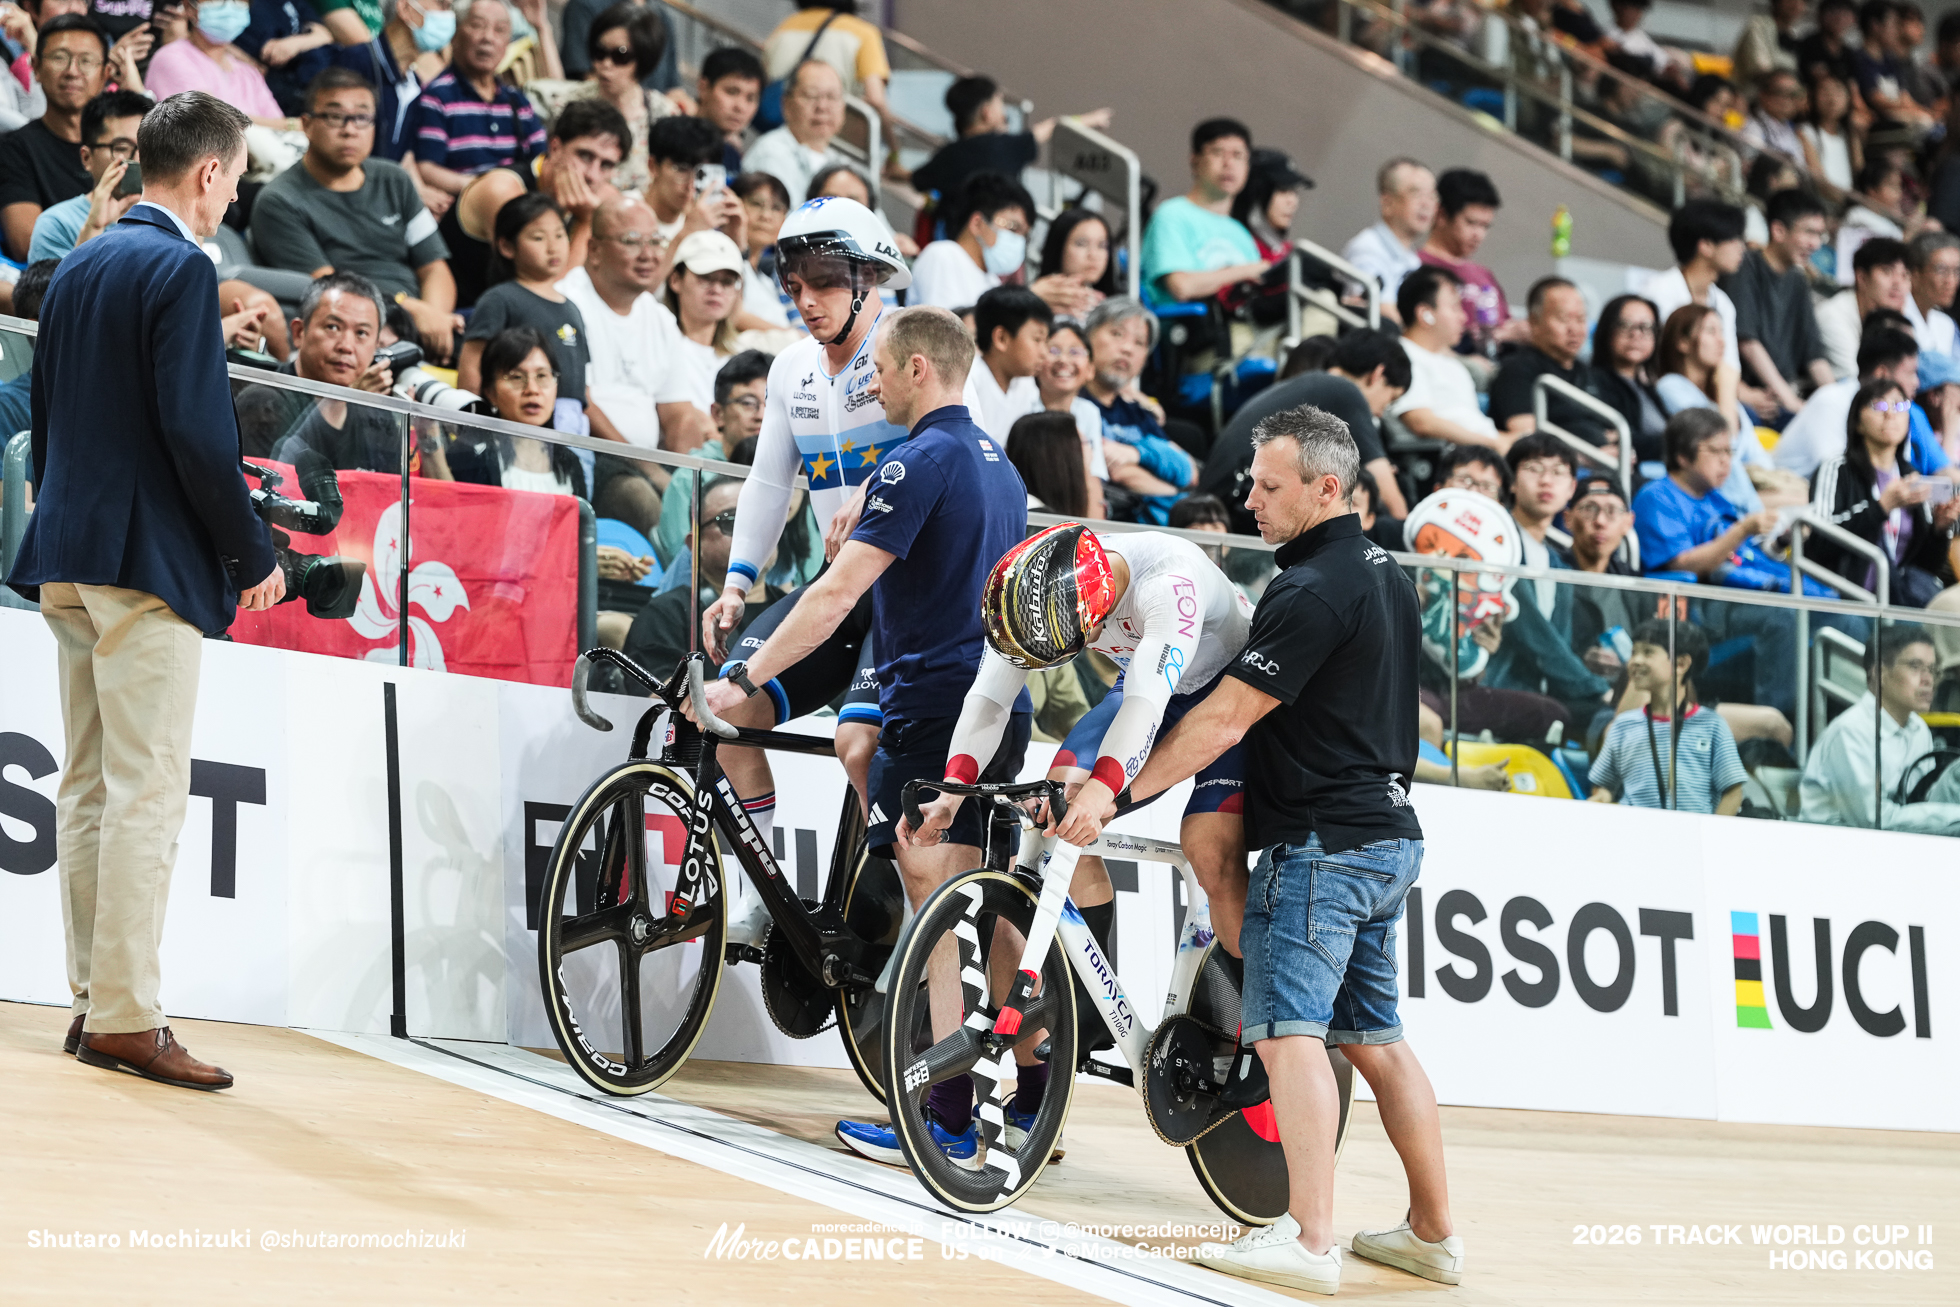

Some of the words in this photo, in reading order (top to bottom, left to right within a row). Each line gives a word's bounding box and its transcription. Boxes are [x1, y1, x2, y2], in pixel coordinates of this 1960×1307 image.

[875, 241, 905, 263] LAZ
[793, 391, 817, 401] LLOYDS
[795, 406, 819, 414] BRITISH
[1085, 539, 1109, 601] JAPAN
[1029, 555, 1047, 642] Kabuto
[1156, 643, 1171, 675] KEIRIN
[850, 681, 880, 692] LLOY
[1139, 722, 1156, 761] Cyclers
[680, 789, 713, 902] LOTUS
[715, 777, 777, 877] hope
[1106, 840, 1118, 849] Toray
[1118, 840, 1133, 850] Carbon
[1134, 843, 1147, 853] Magic
[1405, 887, 1694, 1017] ISSOT
[1084, 938, 1133, 1030] TORAYCA
[1769, 914, 1932, 1039] UCI
[1109, 1009, 1128, 1038] T1100G
